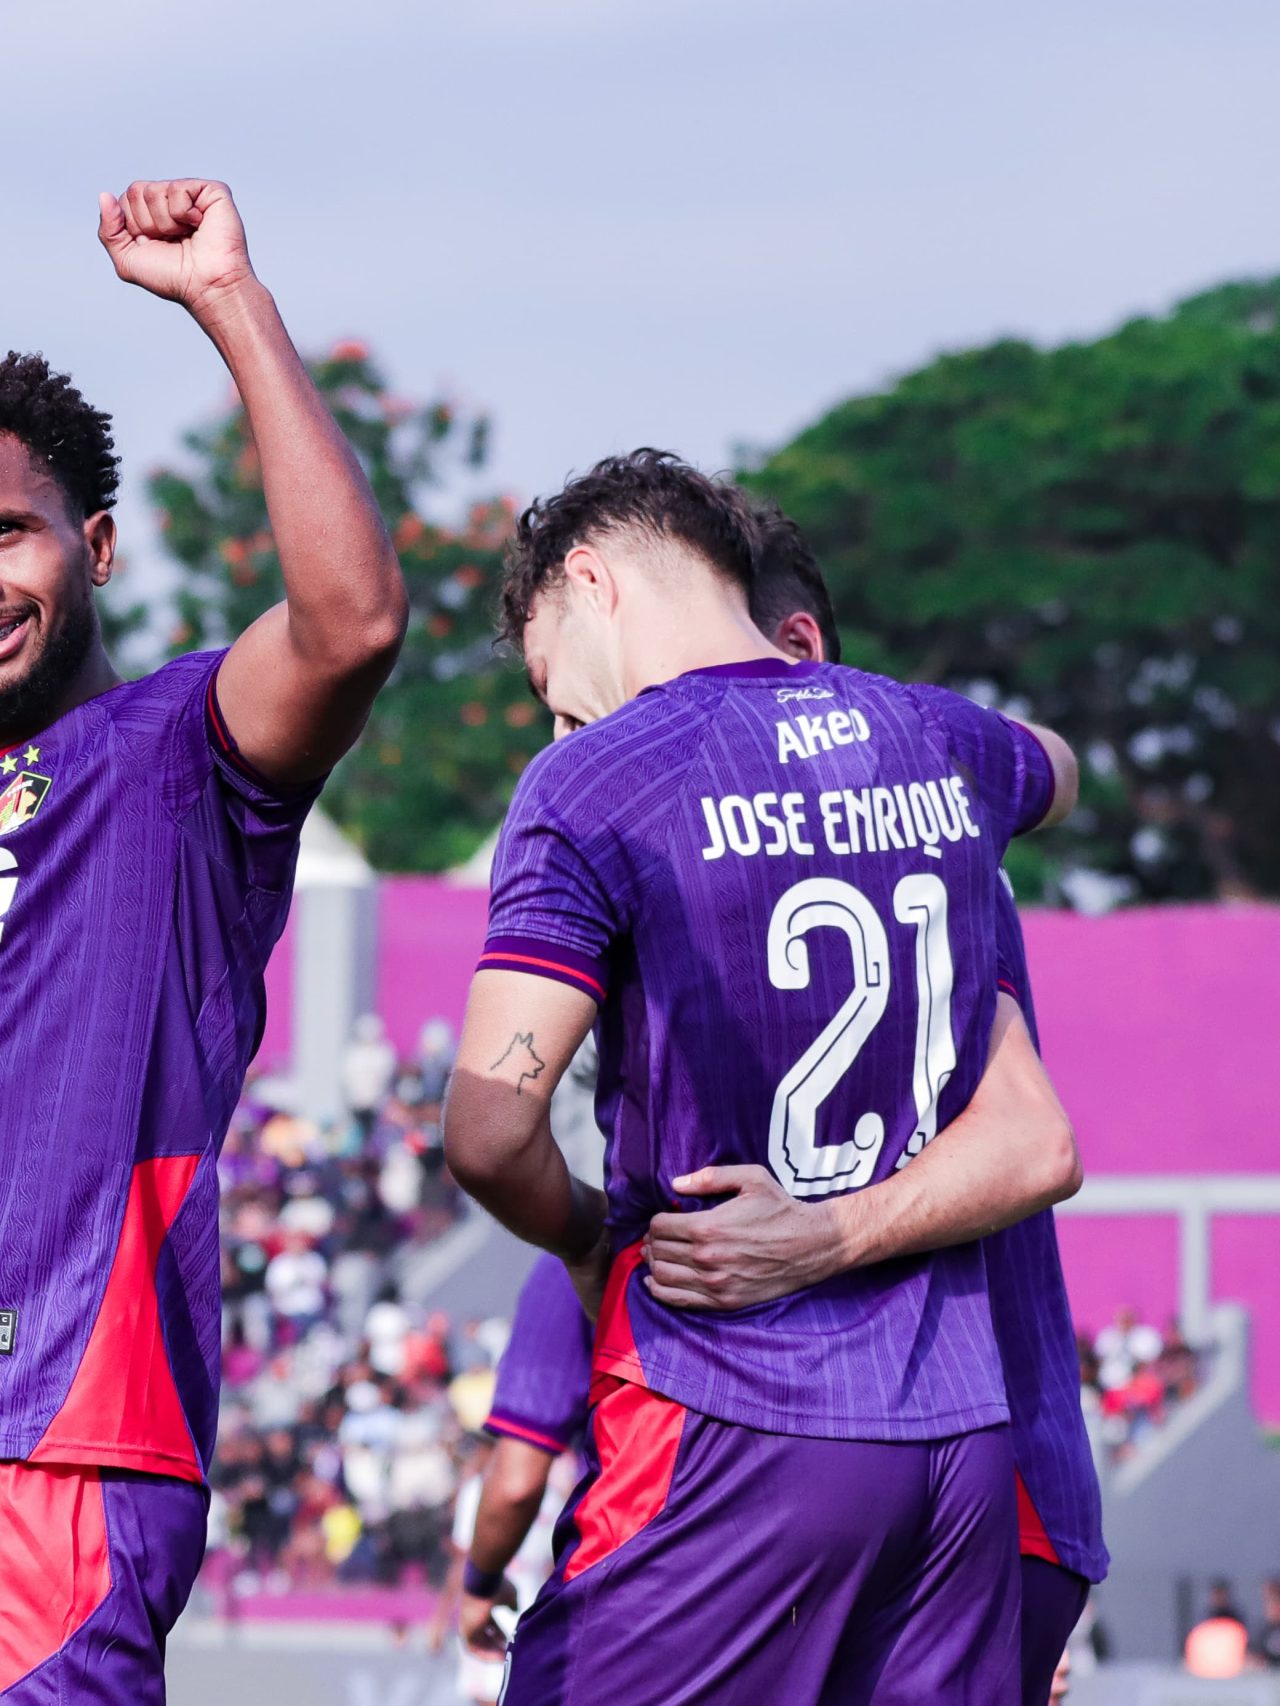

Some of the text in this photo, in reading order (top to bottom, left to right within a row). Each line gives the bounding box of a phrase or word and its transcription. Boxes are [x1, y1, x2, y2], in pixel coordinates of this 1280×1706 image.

[775, 708, 871, 764] Akeo
[700, 775, 980, 861] JOSE ENRIQUE
[766, 873, 957, 1198] 21
